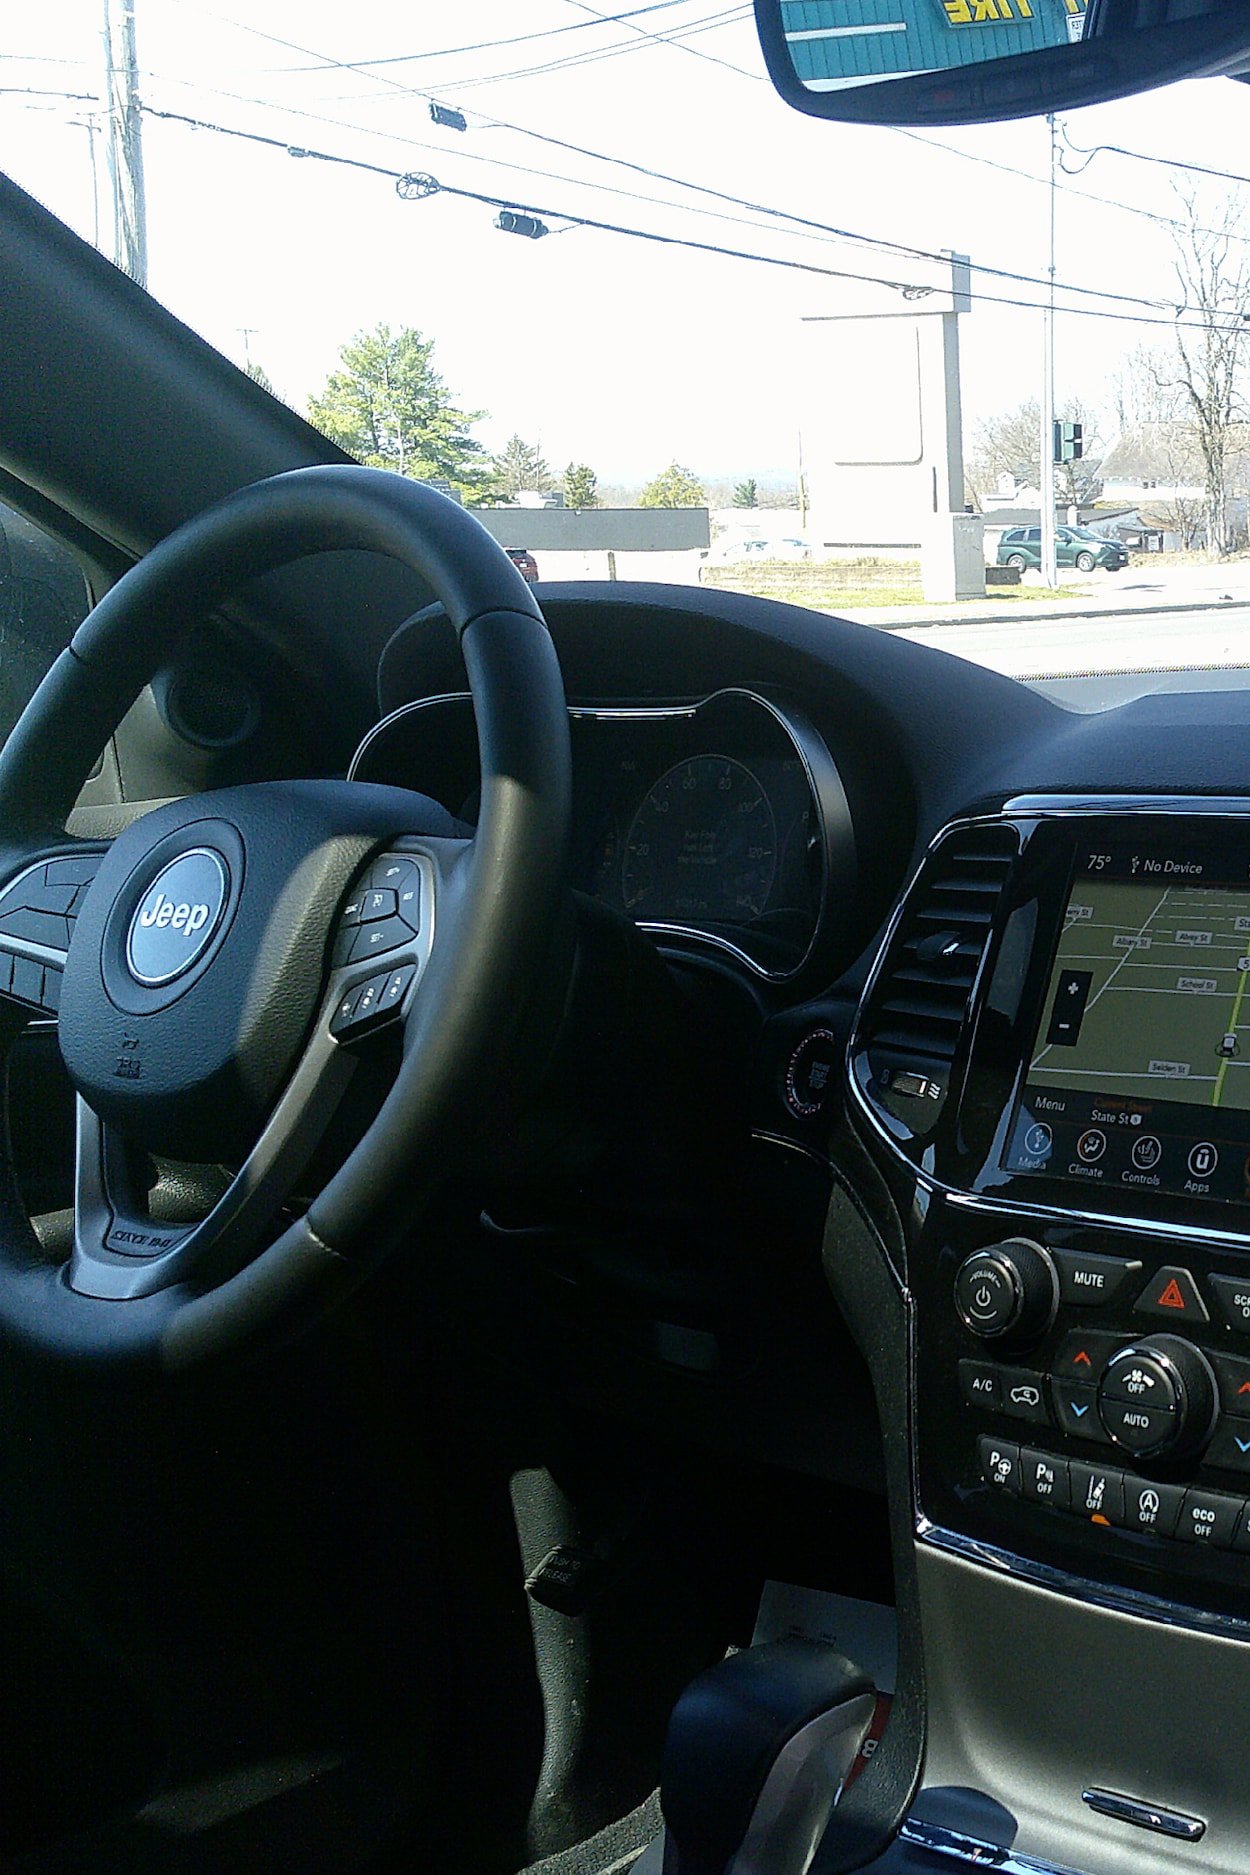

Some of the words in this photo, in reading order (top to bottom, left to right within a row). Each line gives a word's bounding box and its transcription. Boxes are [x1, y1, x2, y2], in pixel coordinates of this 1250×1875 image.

[1087, 854, 1112, 870] 75°
[1143, 859, 1161, 873] No
[1164, 860, 1203, 875] Device
[141, 893, 209, 937] Jeep
[1035, 1096, 1066, 1112] Menu
[1091, 1109, 1116, 1124] State
[1118, 1112, 1129, 1125] St
[1018, 1156, 1047, 1170] Media
[1068, 1163, 1104, 1178] Climate
[1121, 1171, 1161, 1187] Controls
[1184, 1179, 1210, 1193] Apps
[973, 1270, 998, 1284] VOLUME
[1074, 1271, 1105, 1288] MUTE
[973, 1378, 993, 1392] A/C
[1127, 1382, 1145, 1395] OFF
[1123, 1412, 1149, 1428] AUTO
[993, 1473, 1006, 1484] ON
[1037, 1482, 1053, 1495] OFF
[1086, 1498, 1103, 1511] OFF
[1139, 1511, 1157, 1524] OFF
[1192, 1507, 1216, 1523] eco
[1194, 1524, 1212, 1537] OFF
